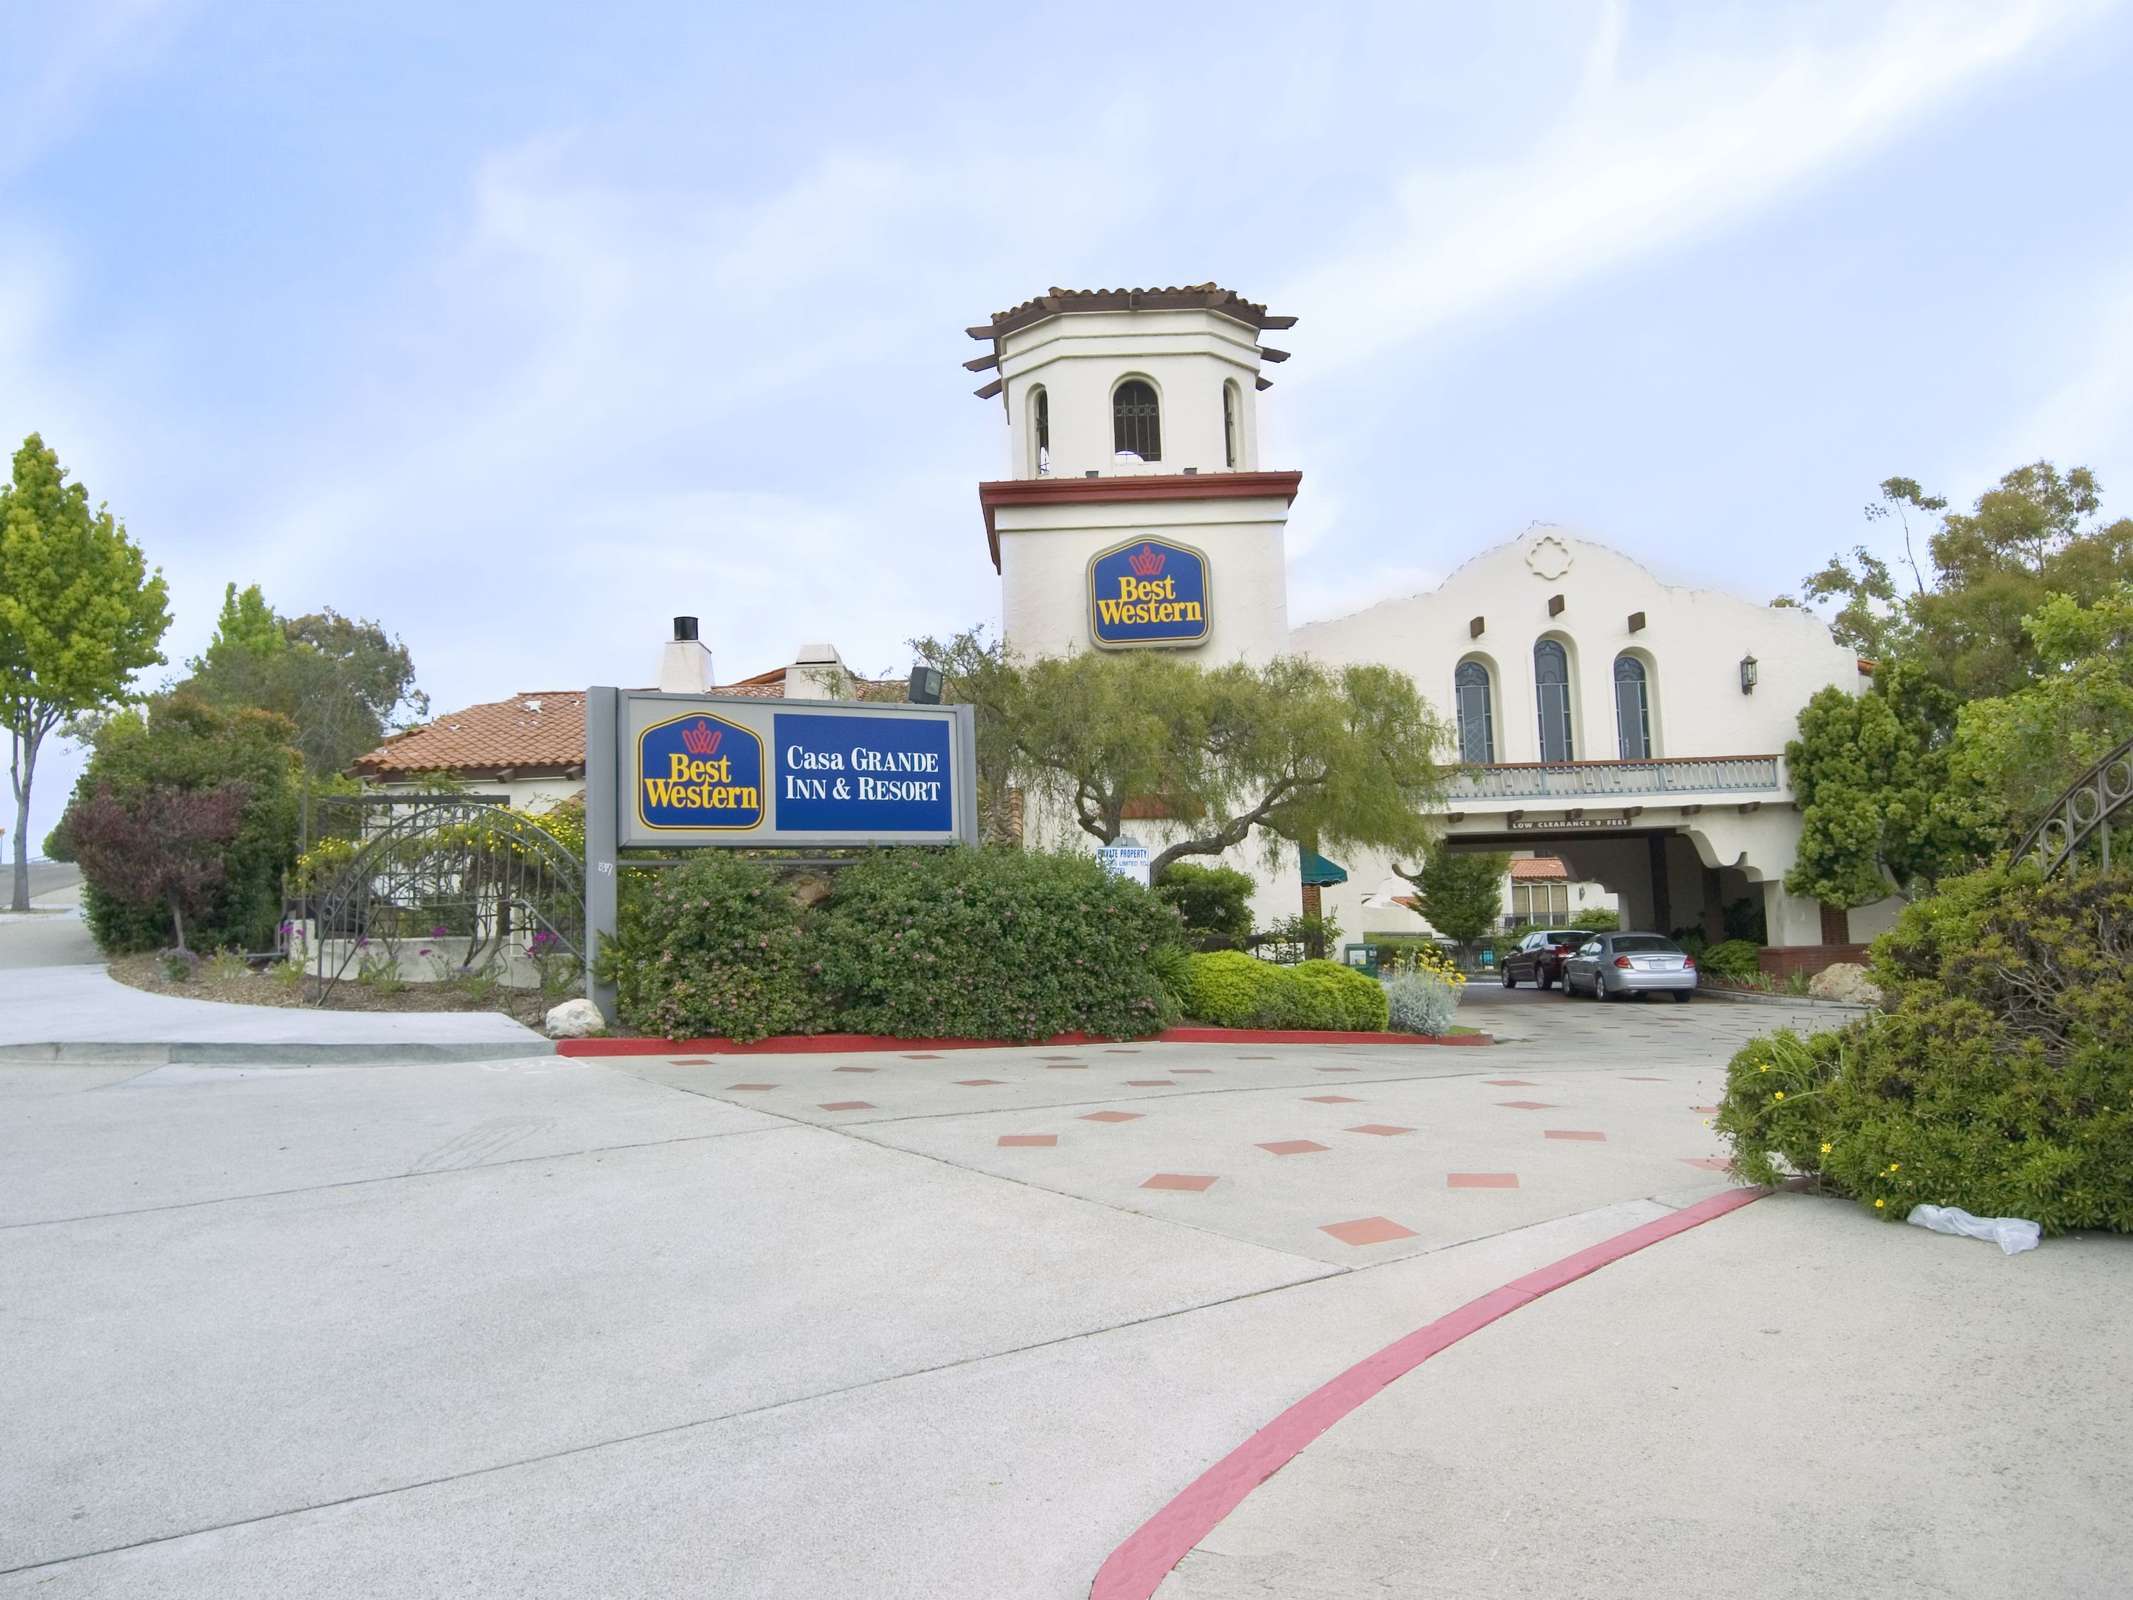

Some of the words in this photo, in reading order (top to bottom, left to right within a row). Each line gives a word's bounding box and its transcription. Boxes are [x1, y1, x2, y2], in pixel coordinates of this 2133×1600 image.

[1118, 575, 1176, 602] Best
[1097, 599, 1203, 625] Western
[668, 753, 732, 784] Best
[787, 745, 845, 770] Casa
[851, 747, 939, 773] GRANDE
[644, 778, 759, 809] Western
[785, 775, 827, 800] INN
[832, 777, 851, 800] &
[858, 776, 941, 802] RESORT
[1512, 822, 1533, 830] LOW
[1538, 820, 1591, 828] CLEARANCE
[1606, 818, 1629, 826] FEET
[1120, 849, 1147, 858] PROPERTY
